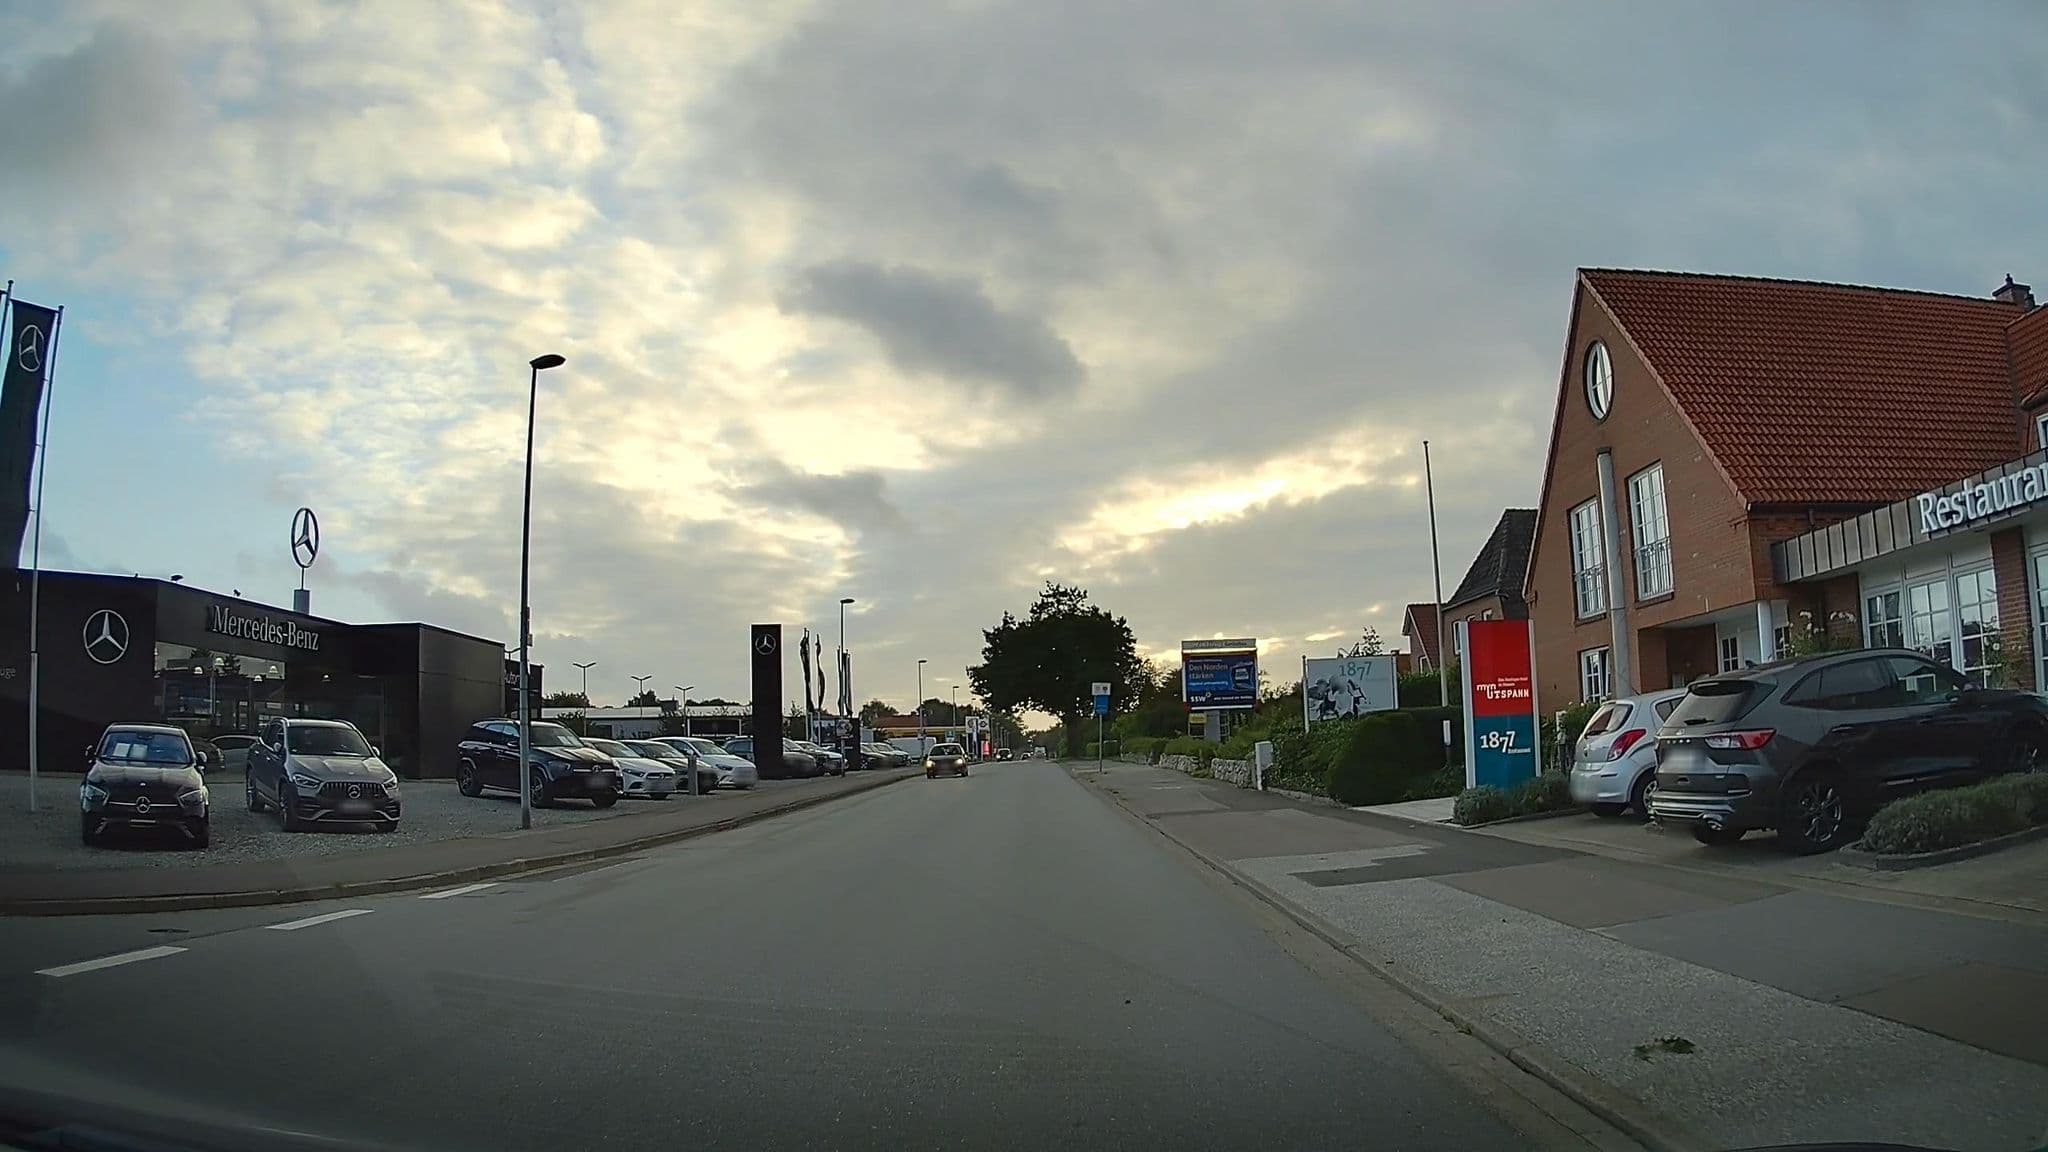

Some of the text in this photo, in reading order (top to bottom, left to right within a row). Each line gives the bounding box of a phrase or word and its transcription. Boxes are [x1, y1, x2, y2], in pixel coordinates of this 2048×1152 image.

[212, 605, 319, 651] Mercedes-Benz
[1340, 661, 1373, 680] 1877
[1480, 730, 1516, 753] 1877
